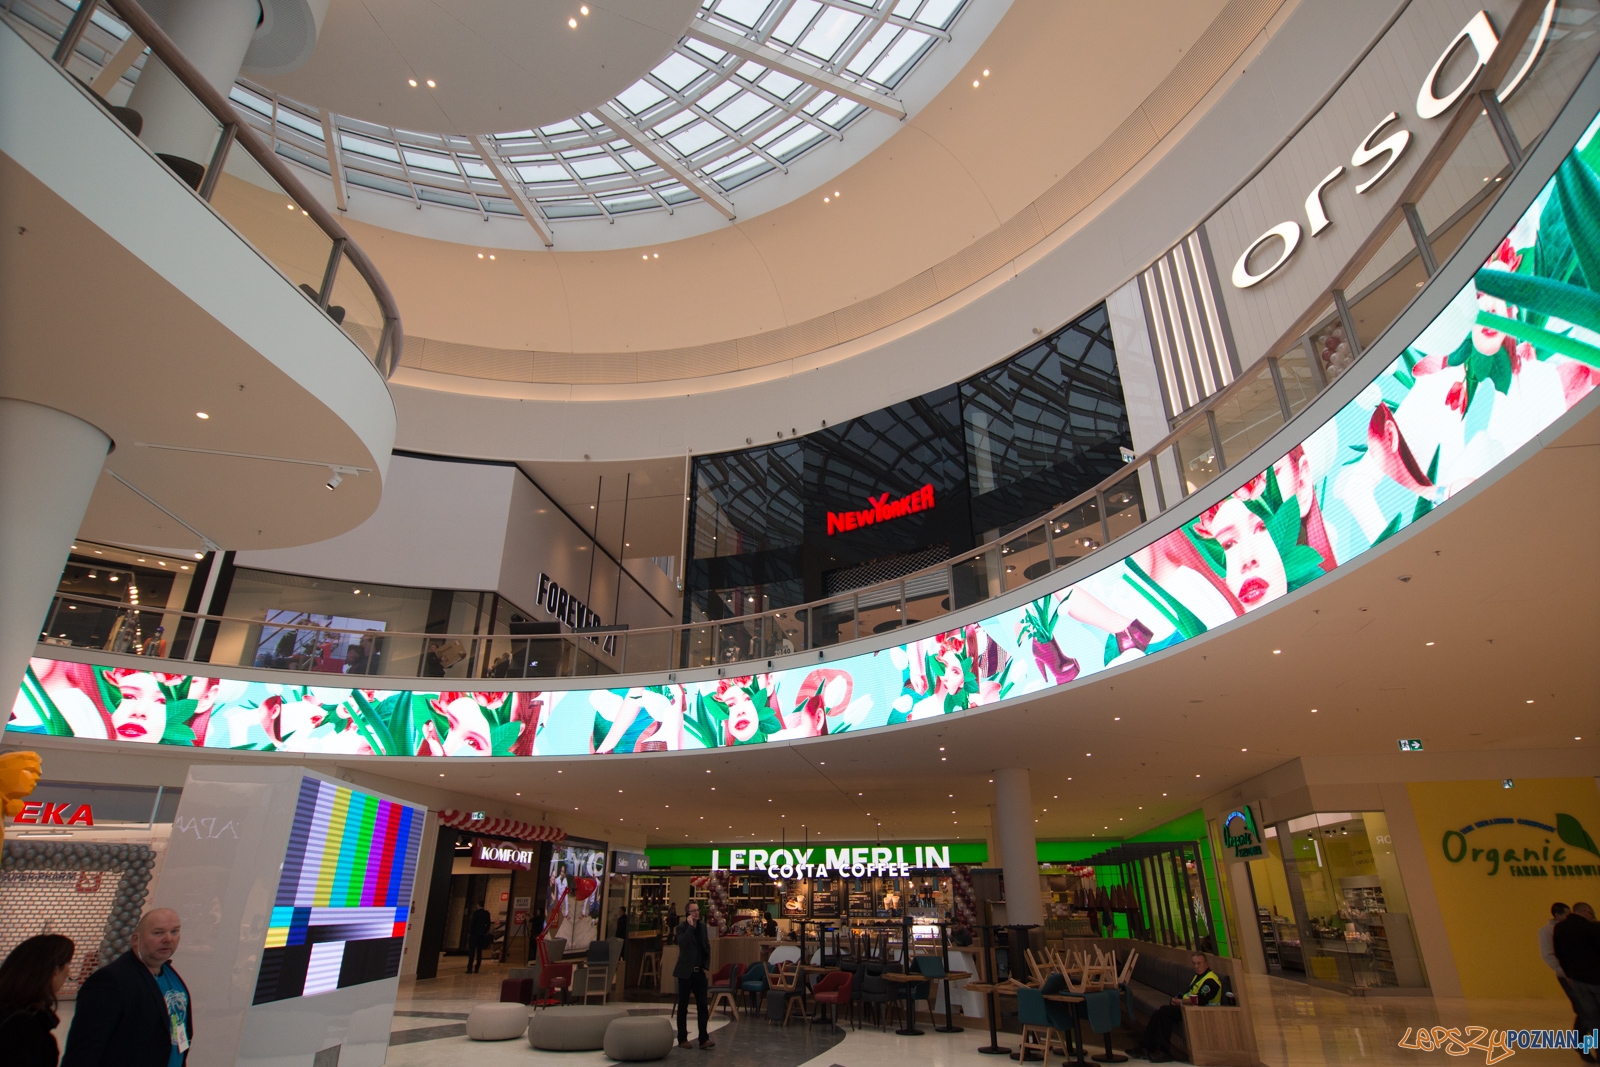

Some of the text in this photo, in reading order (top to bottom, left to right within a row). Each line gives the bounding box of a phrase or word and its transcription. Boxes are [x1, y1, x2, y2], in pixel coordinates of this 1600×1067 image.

[13, 801, 94, 826] EKA
[481, 846, 534, 864] KOMFORT
[618, 858, 629, 867] Salon
[712, 846, 951, 871] LEROY MERLIN
[1442, 830, 1567, 877] Organic
[767, 862, 910, 880] COSTA COFFEE
[1509, 865, 1548, 877] FARMA
